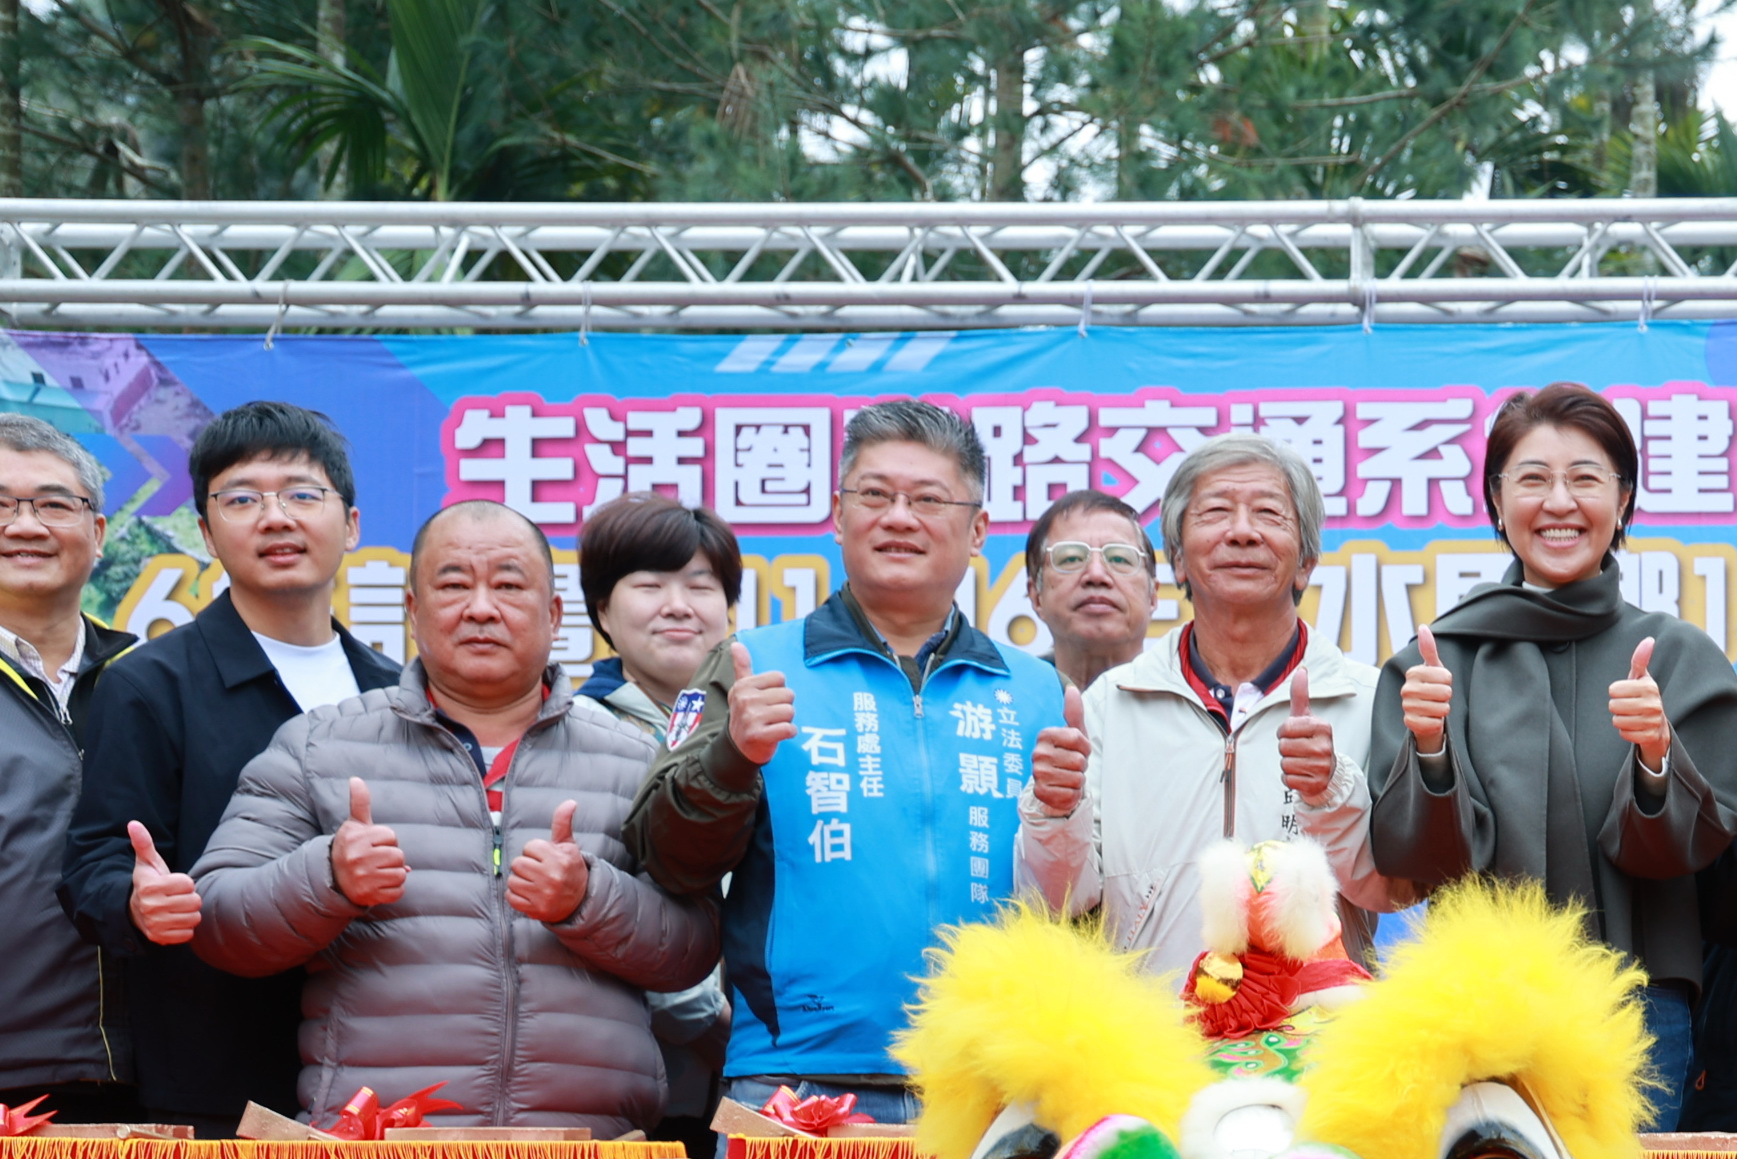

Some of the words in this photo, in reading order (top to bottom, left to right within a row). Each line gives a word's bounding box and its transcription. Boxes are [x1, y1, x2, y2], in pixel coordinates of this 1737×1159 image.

[801, 725, 852, 864] 石智伯
[852, 691, 885, 798] 服務處主任
[996, 706, 1024, 799] 立法委員
[968, 805, 990, 905] 服務團隊
